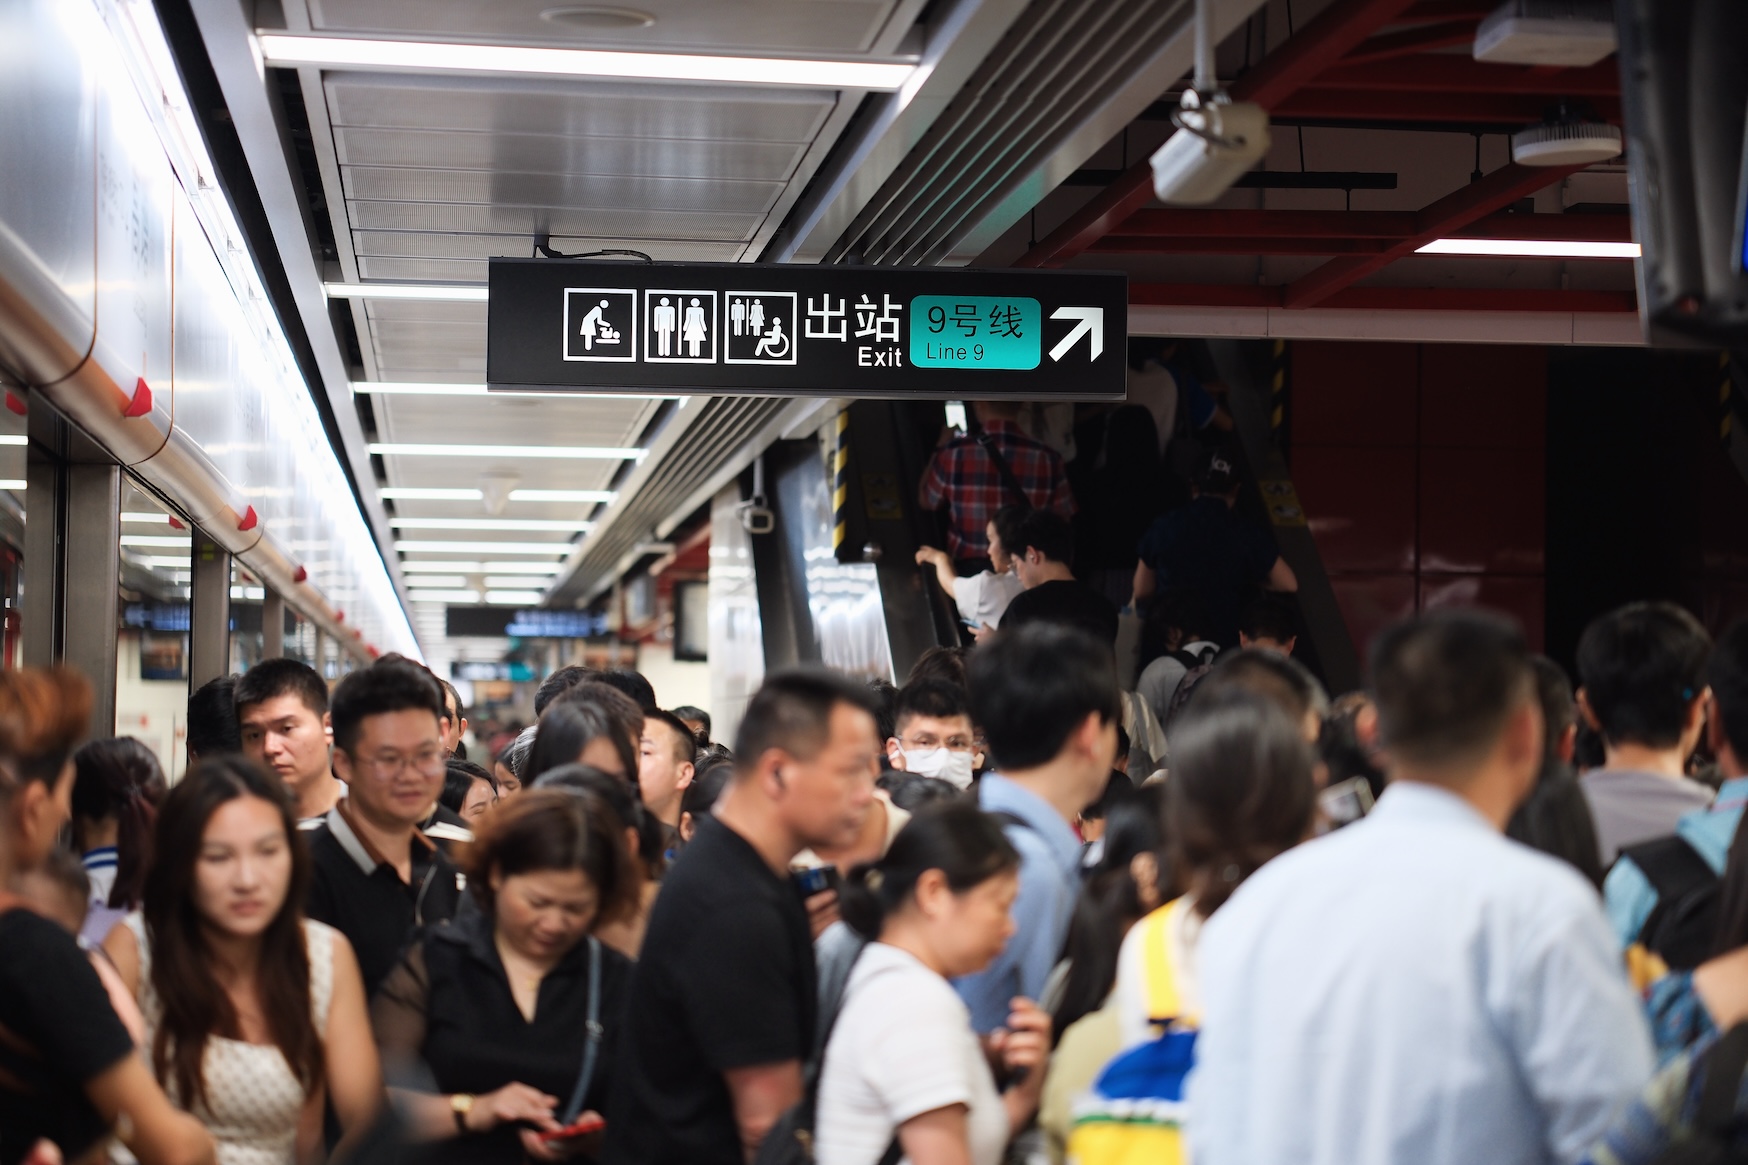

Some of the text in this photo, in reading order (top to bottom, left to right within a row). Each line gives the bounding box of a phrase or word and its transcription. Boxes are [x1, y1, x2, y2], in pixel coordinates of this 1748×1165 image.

[804, 293, 903, 343] 出站
[927, 304, 1024, 339] 9号线
[858, 346, 902, 368] Exit
[926, 342, 984, 361] Line 9
